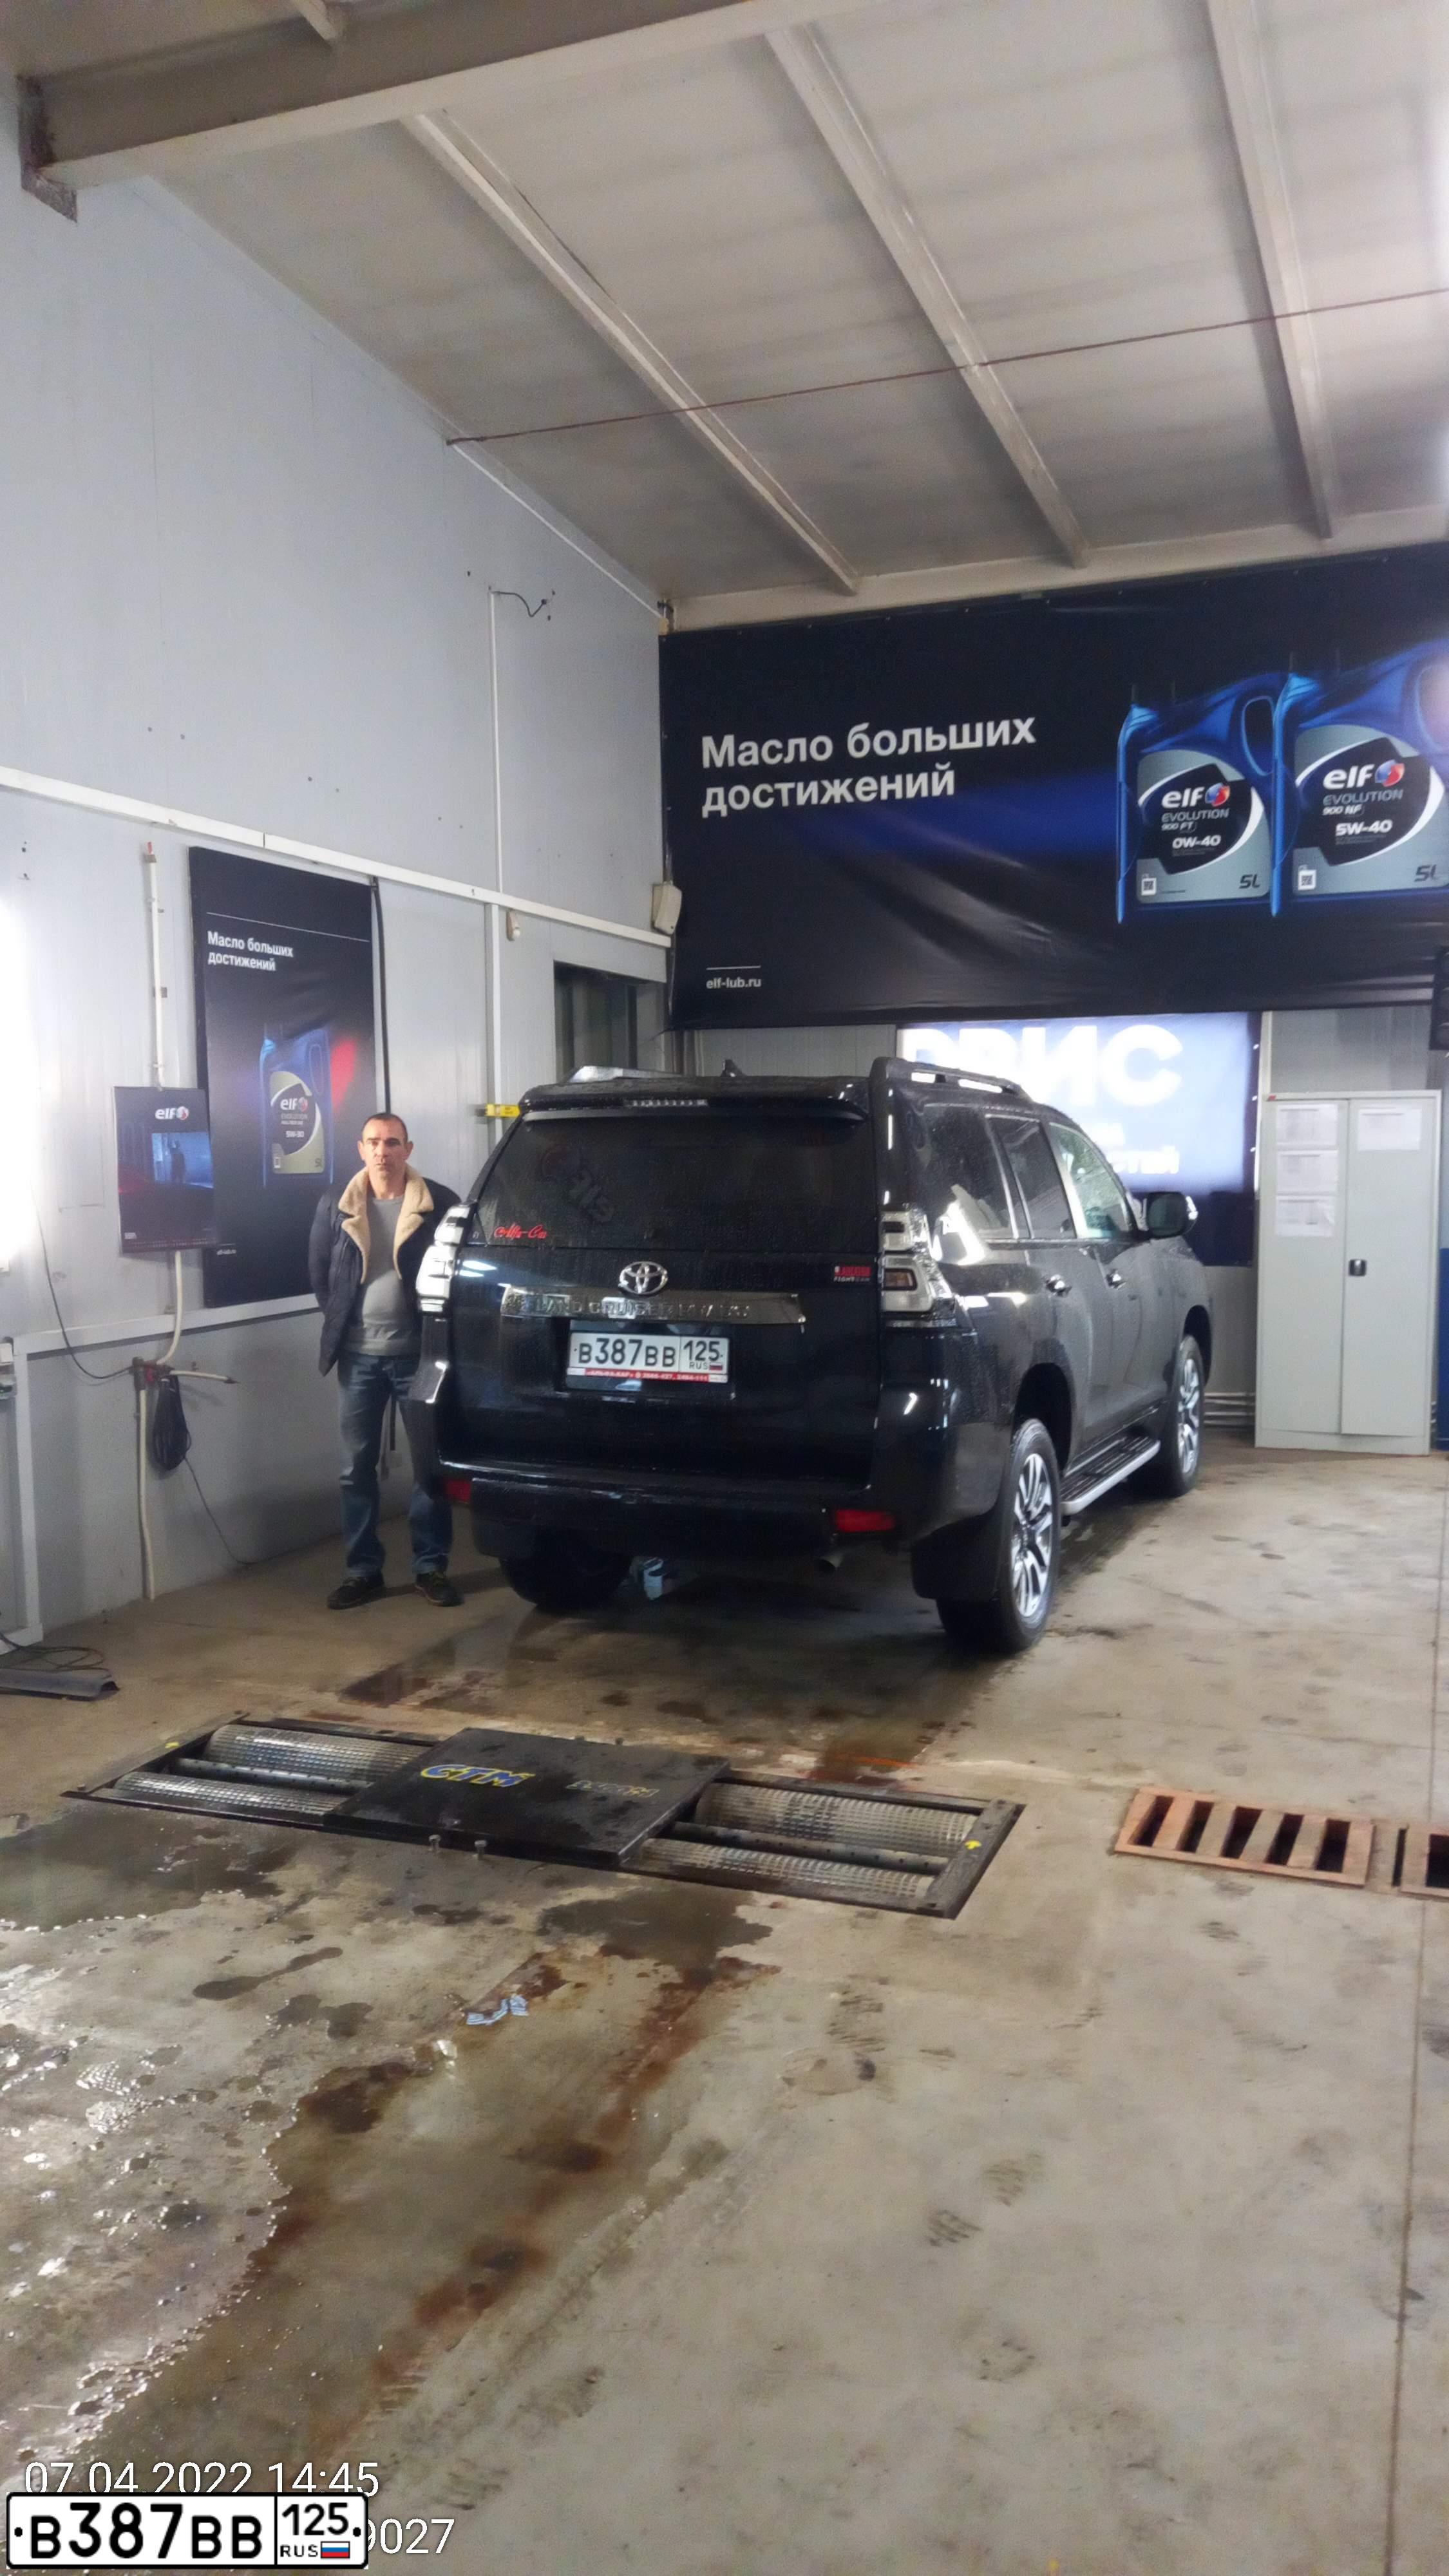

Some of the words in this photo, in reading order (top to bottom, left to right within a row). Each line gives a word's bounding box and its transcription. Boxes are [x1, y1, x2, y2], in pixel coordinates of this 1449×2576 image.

[702, 734, 833, 768] Масло
[847, 717, 1036, 759] больших
[1323, 764, 1375, 790] elf
[702, 762, 955, 818] достижений
[1161, 786, 1205, 809] elf
[1323, 790, 1403, 806] EVOLUTION
[1161, 808, 1230, 823] EVOLUTION
[1323, 806, 1343, 816] 900
[1161, 823, 1179, 831] 900
[1179, 821, 1194, 831] FT
[1336, 819, 1393, 837] 5W-40
[1172, 835, 1222, 849] 0W-40
[1239, 873, 1261, 889] 5L
[207, 930, 245, 951] Масло
[247, 937, 294, 958] больших
[207, 952, 276, 971] достижений
[706, 976, 762, 989] elf-lub.ru
[280, 1097, 298, 1111] elf
[155, 1107, 176, 1120] elf
[579, 1338, 676, 1367] В387ВВ
[683, 1340, 720, 1361] 125
[689, 1361, 708, 1370] RUS
